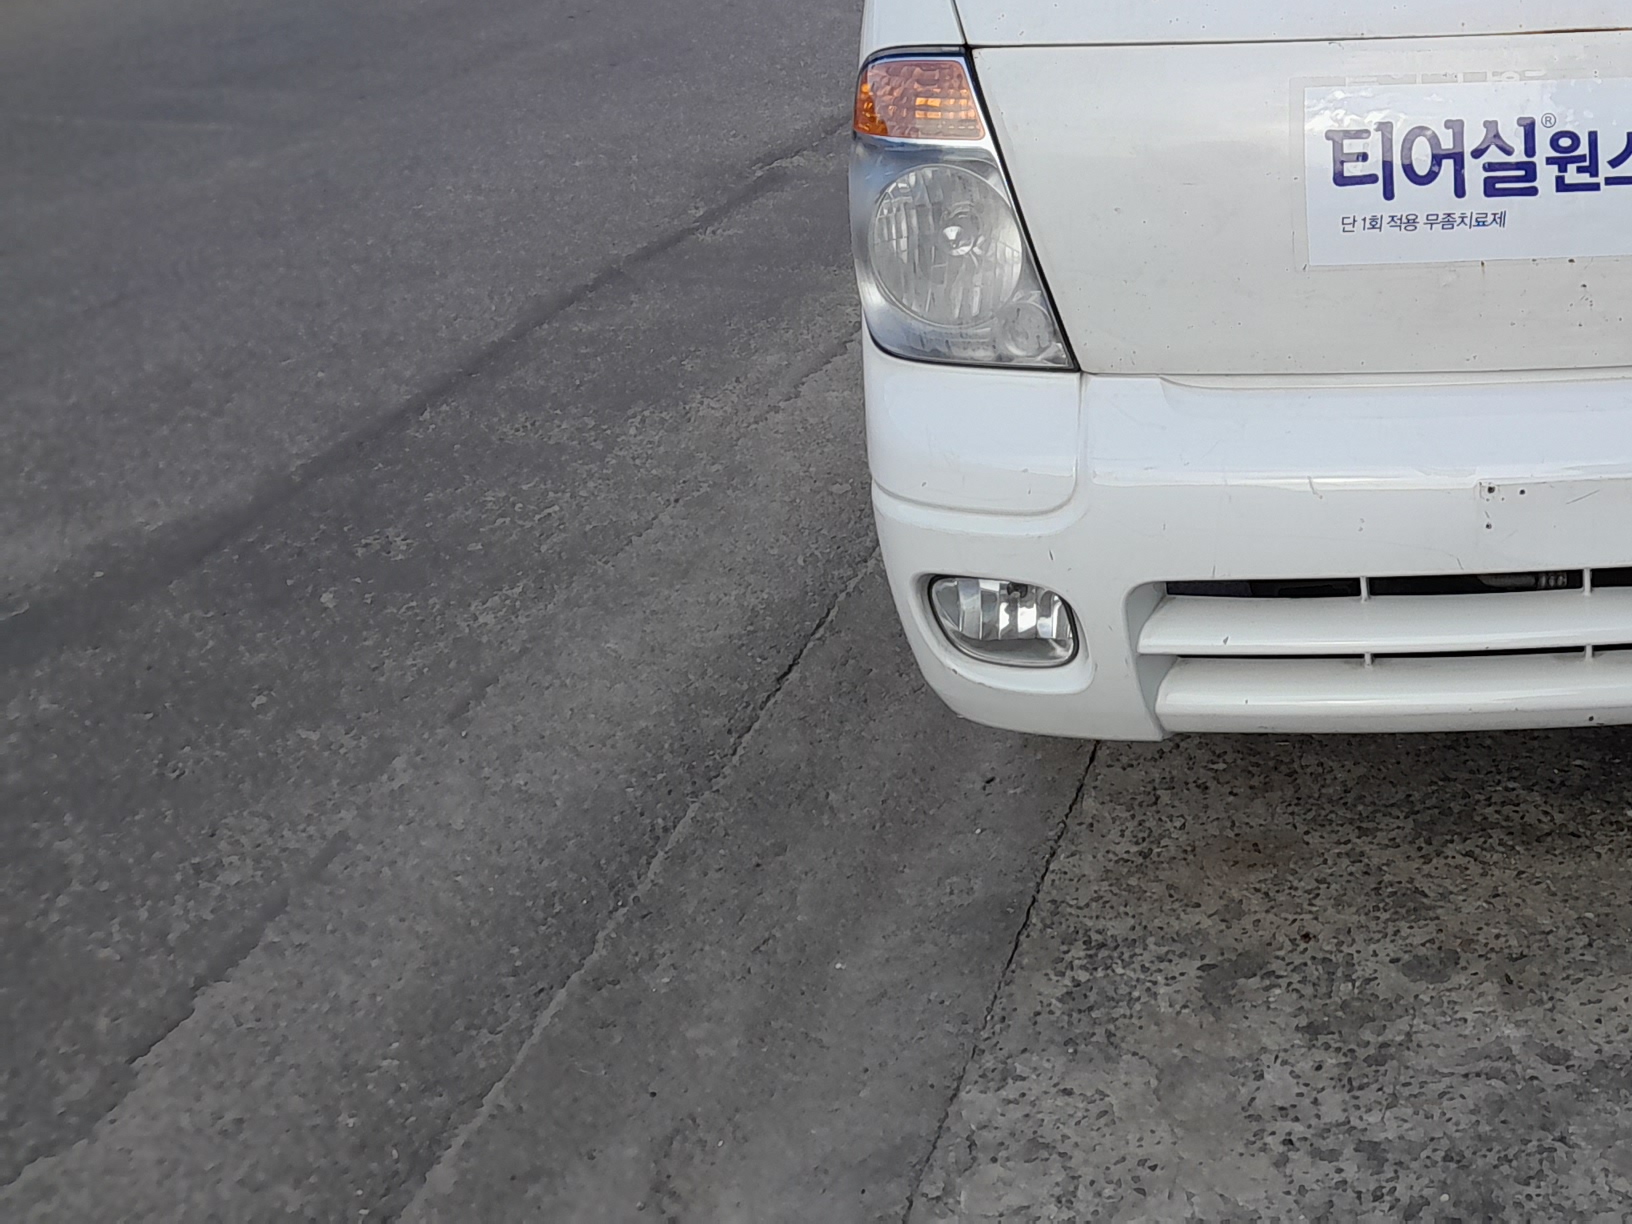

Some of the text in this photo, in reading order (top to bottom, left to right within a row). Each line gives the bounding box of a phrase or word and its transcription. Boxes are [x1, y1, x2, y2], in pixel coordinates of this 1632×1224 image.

[1341, 210, 1507, 233] 단 1회 적용 무좀치료제
